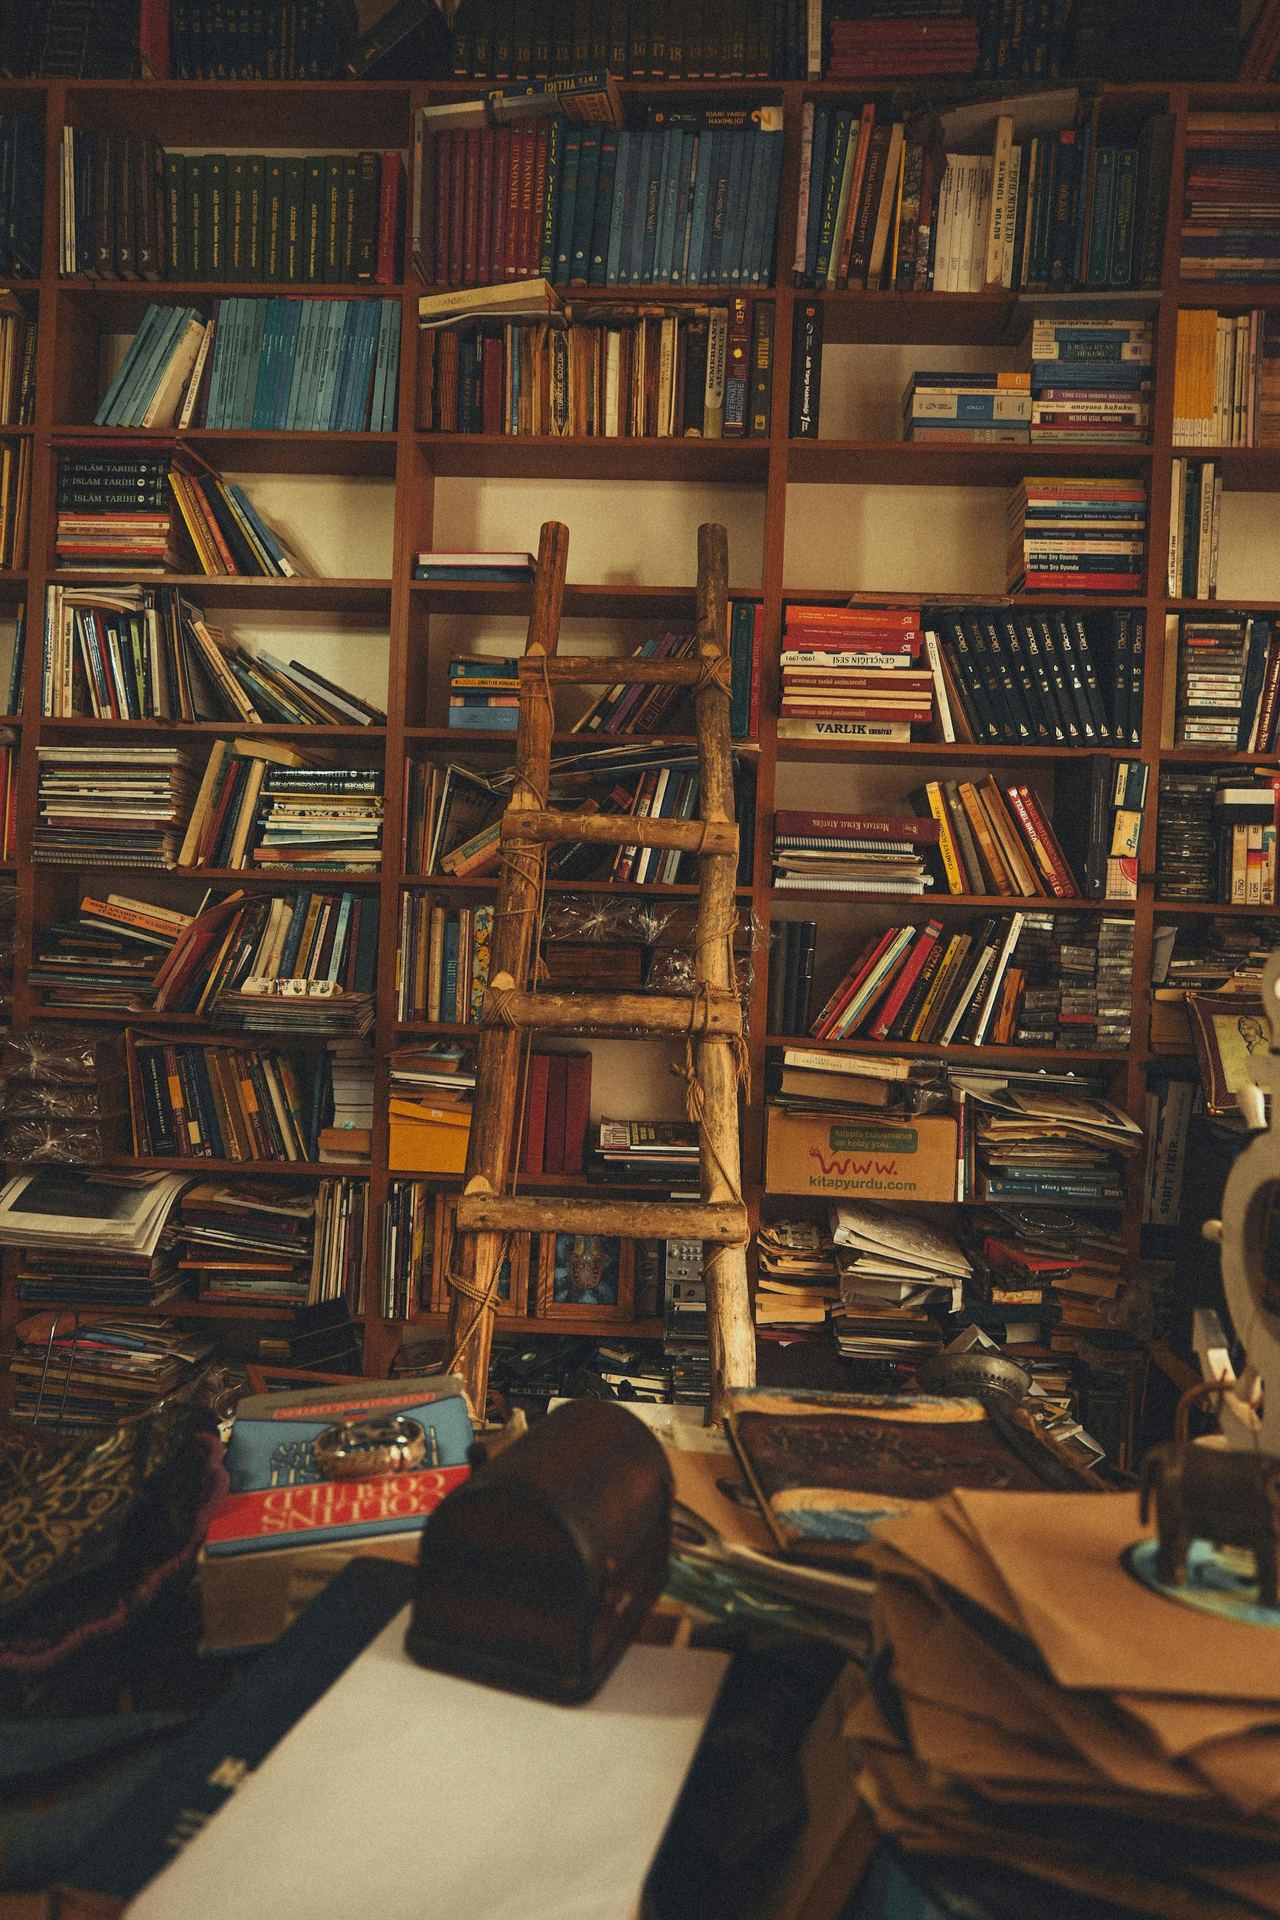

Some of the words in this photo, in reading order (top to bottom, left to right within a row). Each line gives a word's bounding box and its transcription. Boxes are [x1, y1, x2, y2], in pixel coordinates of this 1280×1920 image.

[751, 108, 772, 126] 2
[996, 160, 1006, 200] TÜRKİYE
[993, 207, 1003, 240] BÜYÜK
[1004, 221, 1015, 244] OLTA
[708, 318, 719, 390] SEMERKAND
[716, 326, 726, 388] ALTINOLUK
[804, 355, 812, 369] Adli
[1070, 404, 1102, 412] anayasa
[1103, 402, 1133, 411] hukuku
[104, 477, 135, 486] TARİHİ
[105, 493, 137, 503] TARİHİ
[1201, 482, 1210, 534] GAZİANTEP
[832, 655, 850, 664] SESİ
[853, 655, 896, 665] GENÇLİĞİN
[816, 723, 868, 735] VARLIK
[868, 727, 893, 736] EDEBİYAT
[1014, 799, 1029, 822] TEMEL
[835, 1130, 864, 1140] kitapla
[865, 1131, 913, 1141] buluşmanın
[847, 1139, 870, 1149] kolay
[809, 1176, 917, 1192] kitapyurdu.com
[1159, 1178, 1174, 1216] SABİT
[263, 1473, 446, 1513] COBUILD
[260, 1488, 445, 1533] COLLINS
